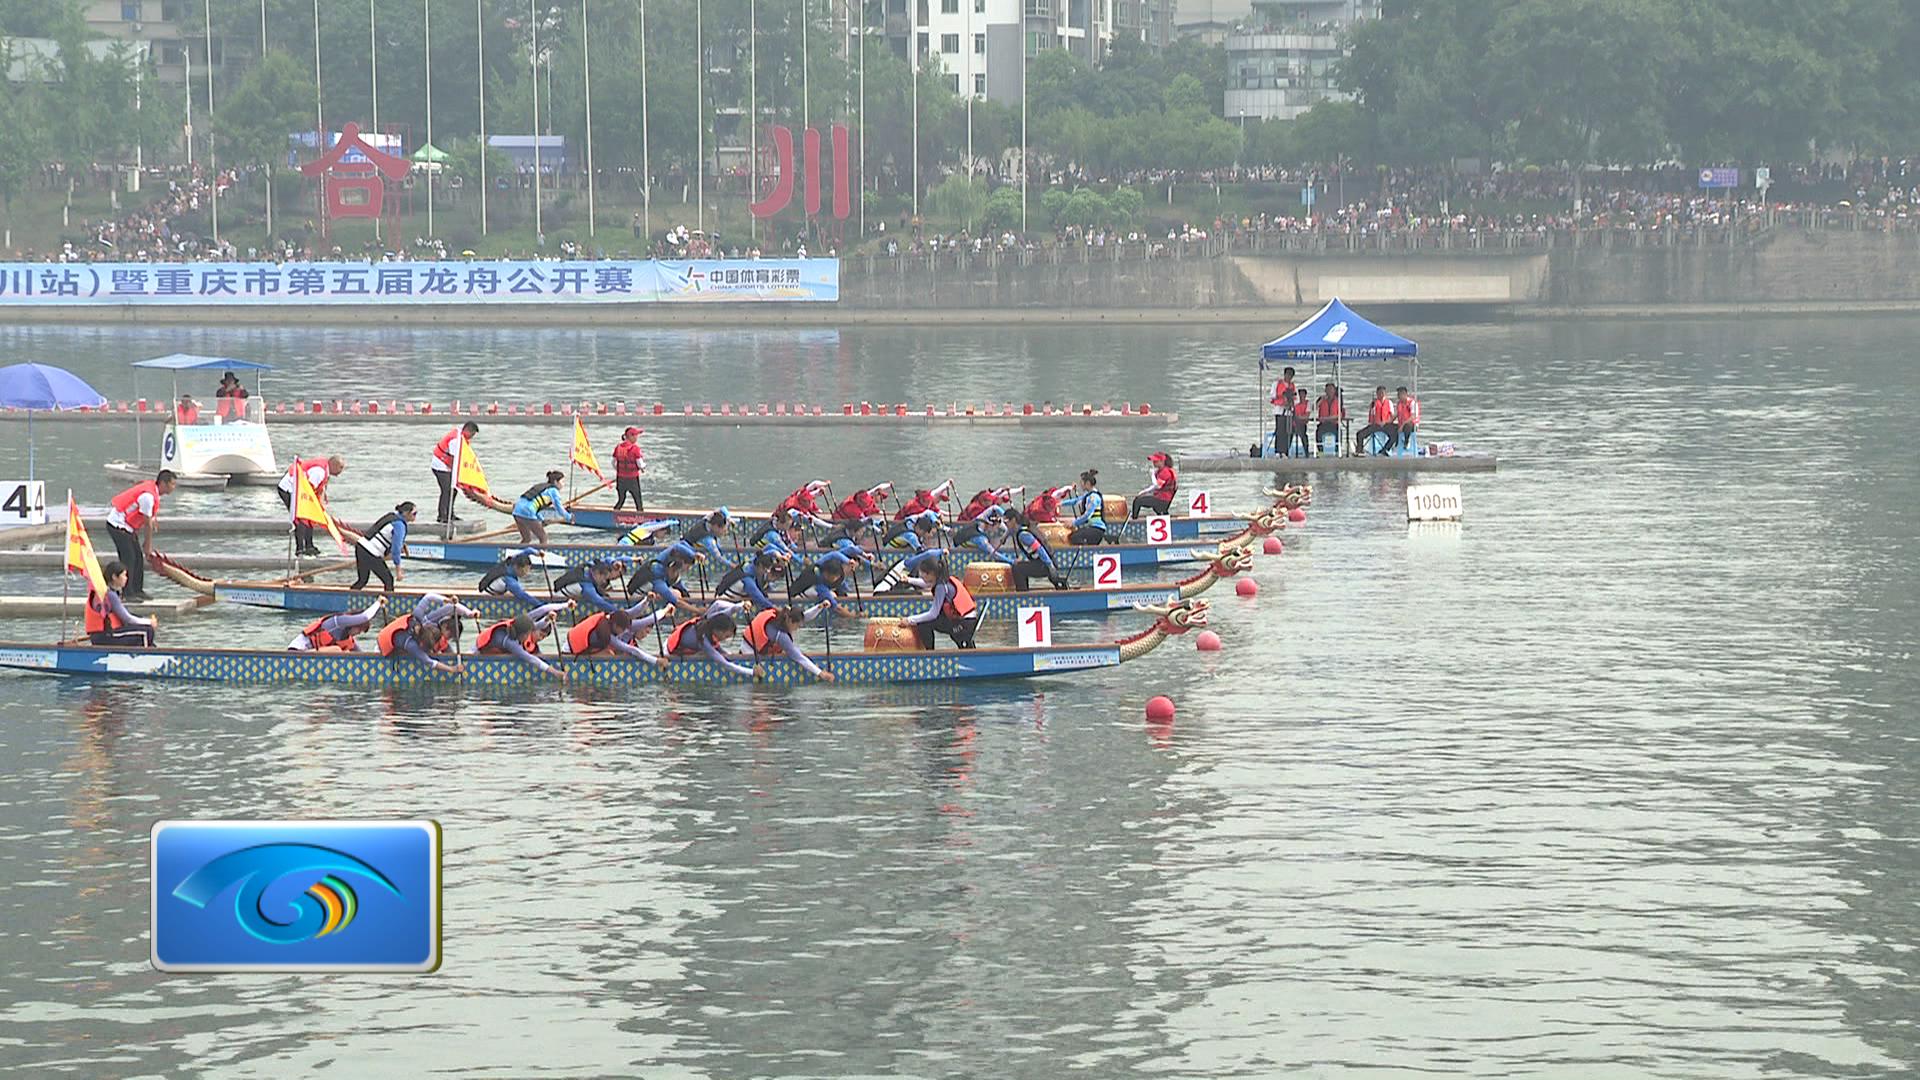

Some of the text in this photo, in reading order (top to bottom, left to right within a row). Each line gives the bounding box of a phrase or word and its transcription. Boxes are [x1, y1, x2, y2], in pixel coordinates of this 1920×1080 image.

[302, 121, 851, 220] 合 川
[710, 269, 800, 283] 中国体育彩票
[166, 437, 174, 458] 2
[2, 485, 32, 518] 4
[34, 484, 44, 517] 4
[1191, 493, 1208, 513] 4
[1414, 494, 1457, 510] 100m
[1150, 518, 1168, 542] 3
[1097, 557, 1118, 584] 2
[1025, 610, 1043, 642] 1
